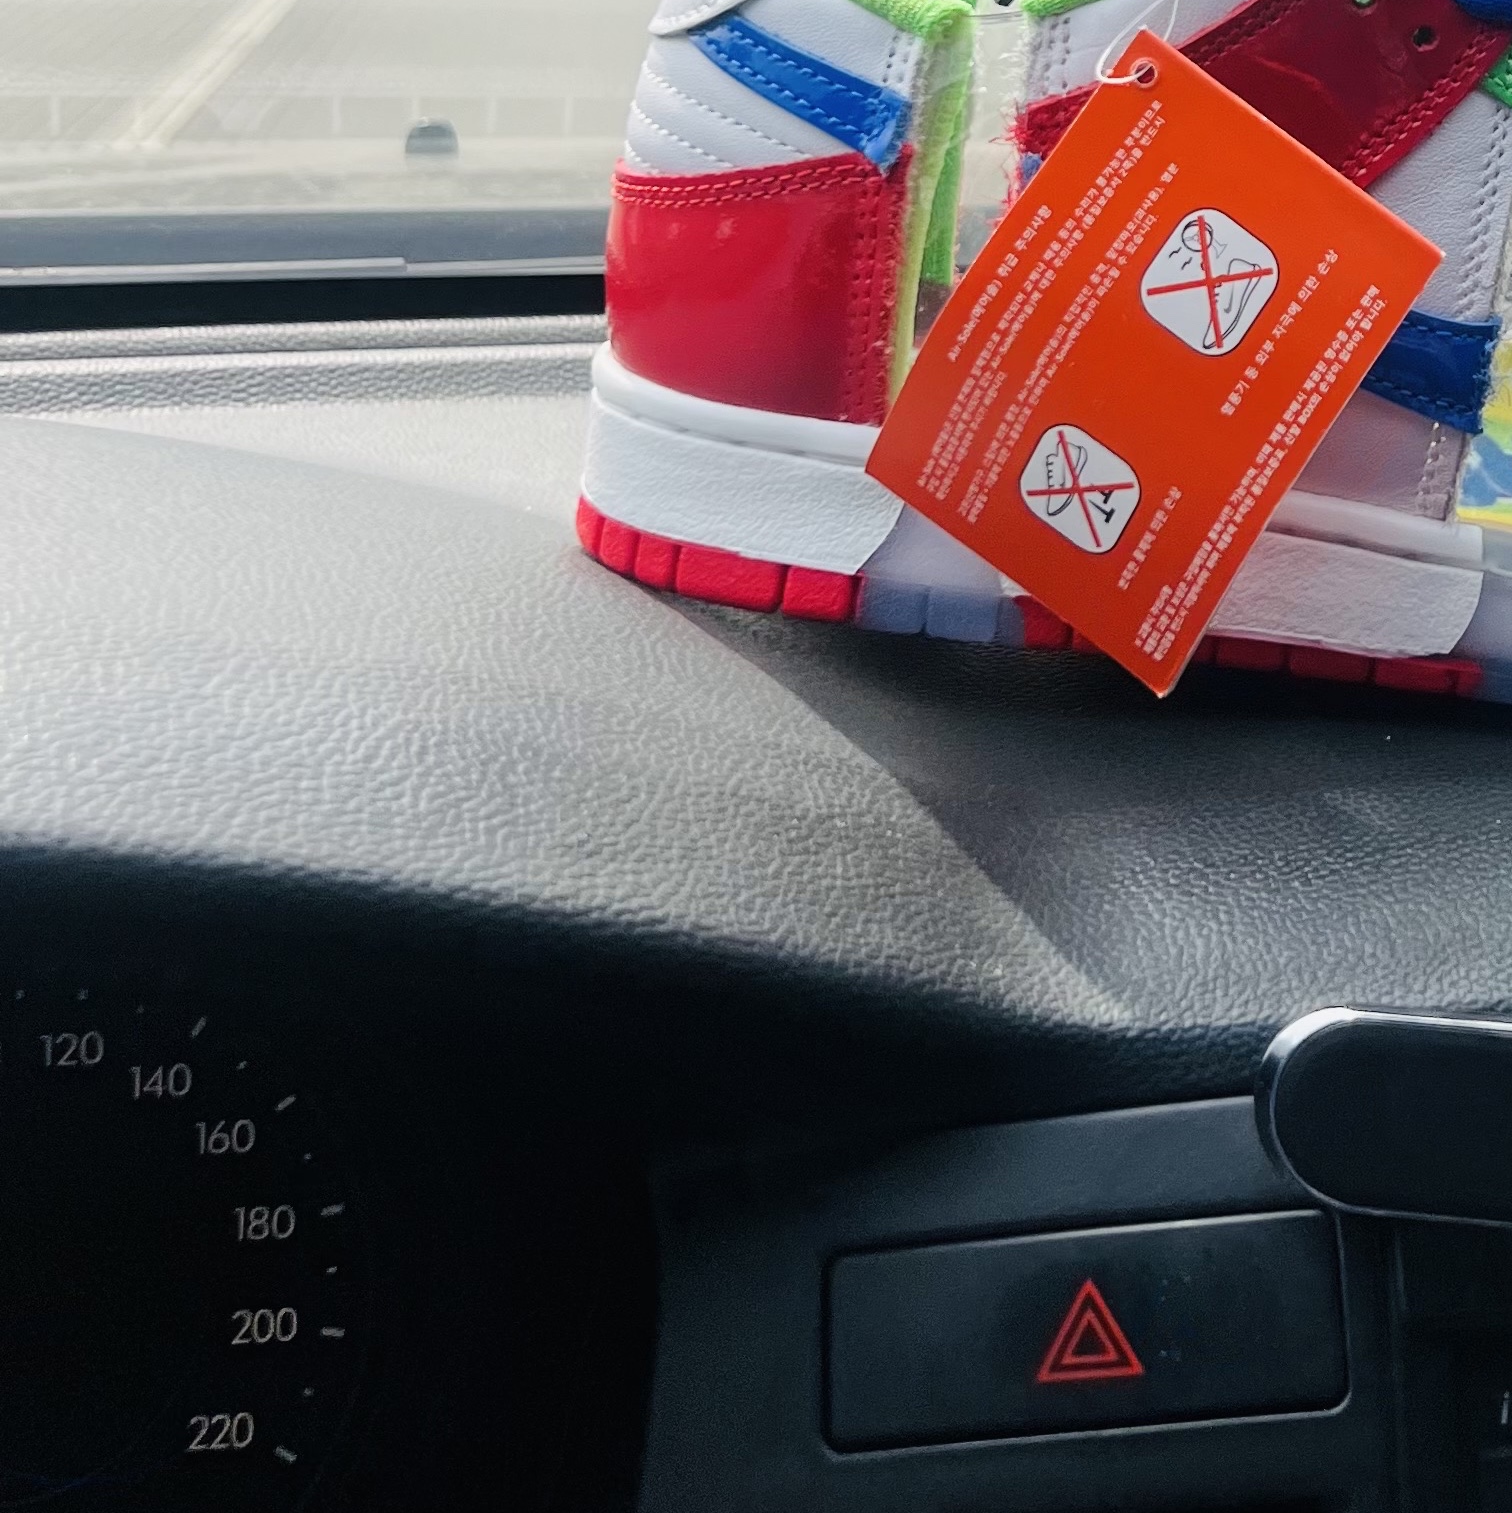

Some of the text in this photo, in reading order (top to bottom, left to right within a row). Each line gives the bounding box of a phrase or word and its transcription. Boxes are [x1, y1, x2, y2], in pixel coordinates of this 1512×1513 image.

[1056, 217, 1077, 239] 등의
[1072, 187, 1099, 218] 수리가
[1094, 147, 1128, 187] 불가능한
[1123, 99, 1162, 147] 부분이므로
[1037, 268, 1057, 290] 대한
[1052, 228, 1085, 268] 주의사항
[1138, 115, 1166, 147] 반드시
[996, 252, 1019, 278] 취급
[1013, 203, 1053, 252] 주의사항
[1116, 254, 1129, 266] 수
[1124, 212, 1159, 254] 있습니다.
[1219, 247, 1339, 417] 열풍기 등 외부 자극에 의한 손상
[1323, 329, 1349, 360] 영수증
[1344, 307, 1365, 330] 또는
[1359, 284, 1380, 307] 판매
[1296, 391, 1322, 425] BOX의
[1317, 361, 1343, 393] 손상이
[1337, 329, 1365, 363] 없어야
[1359, 296, 1388, 331] 합니다.
[1163, 485, 1182, 510] 손상
[39, 1031, 105, 1067] 120
[129, 1062, 192, 1101] 140
[195, 1119, 256, 1155] 160
[233, 1204, 296, 1242] 180
[231, 1307, 298, 1345] 200
[186, 1412, 255, 1452] 220
